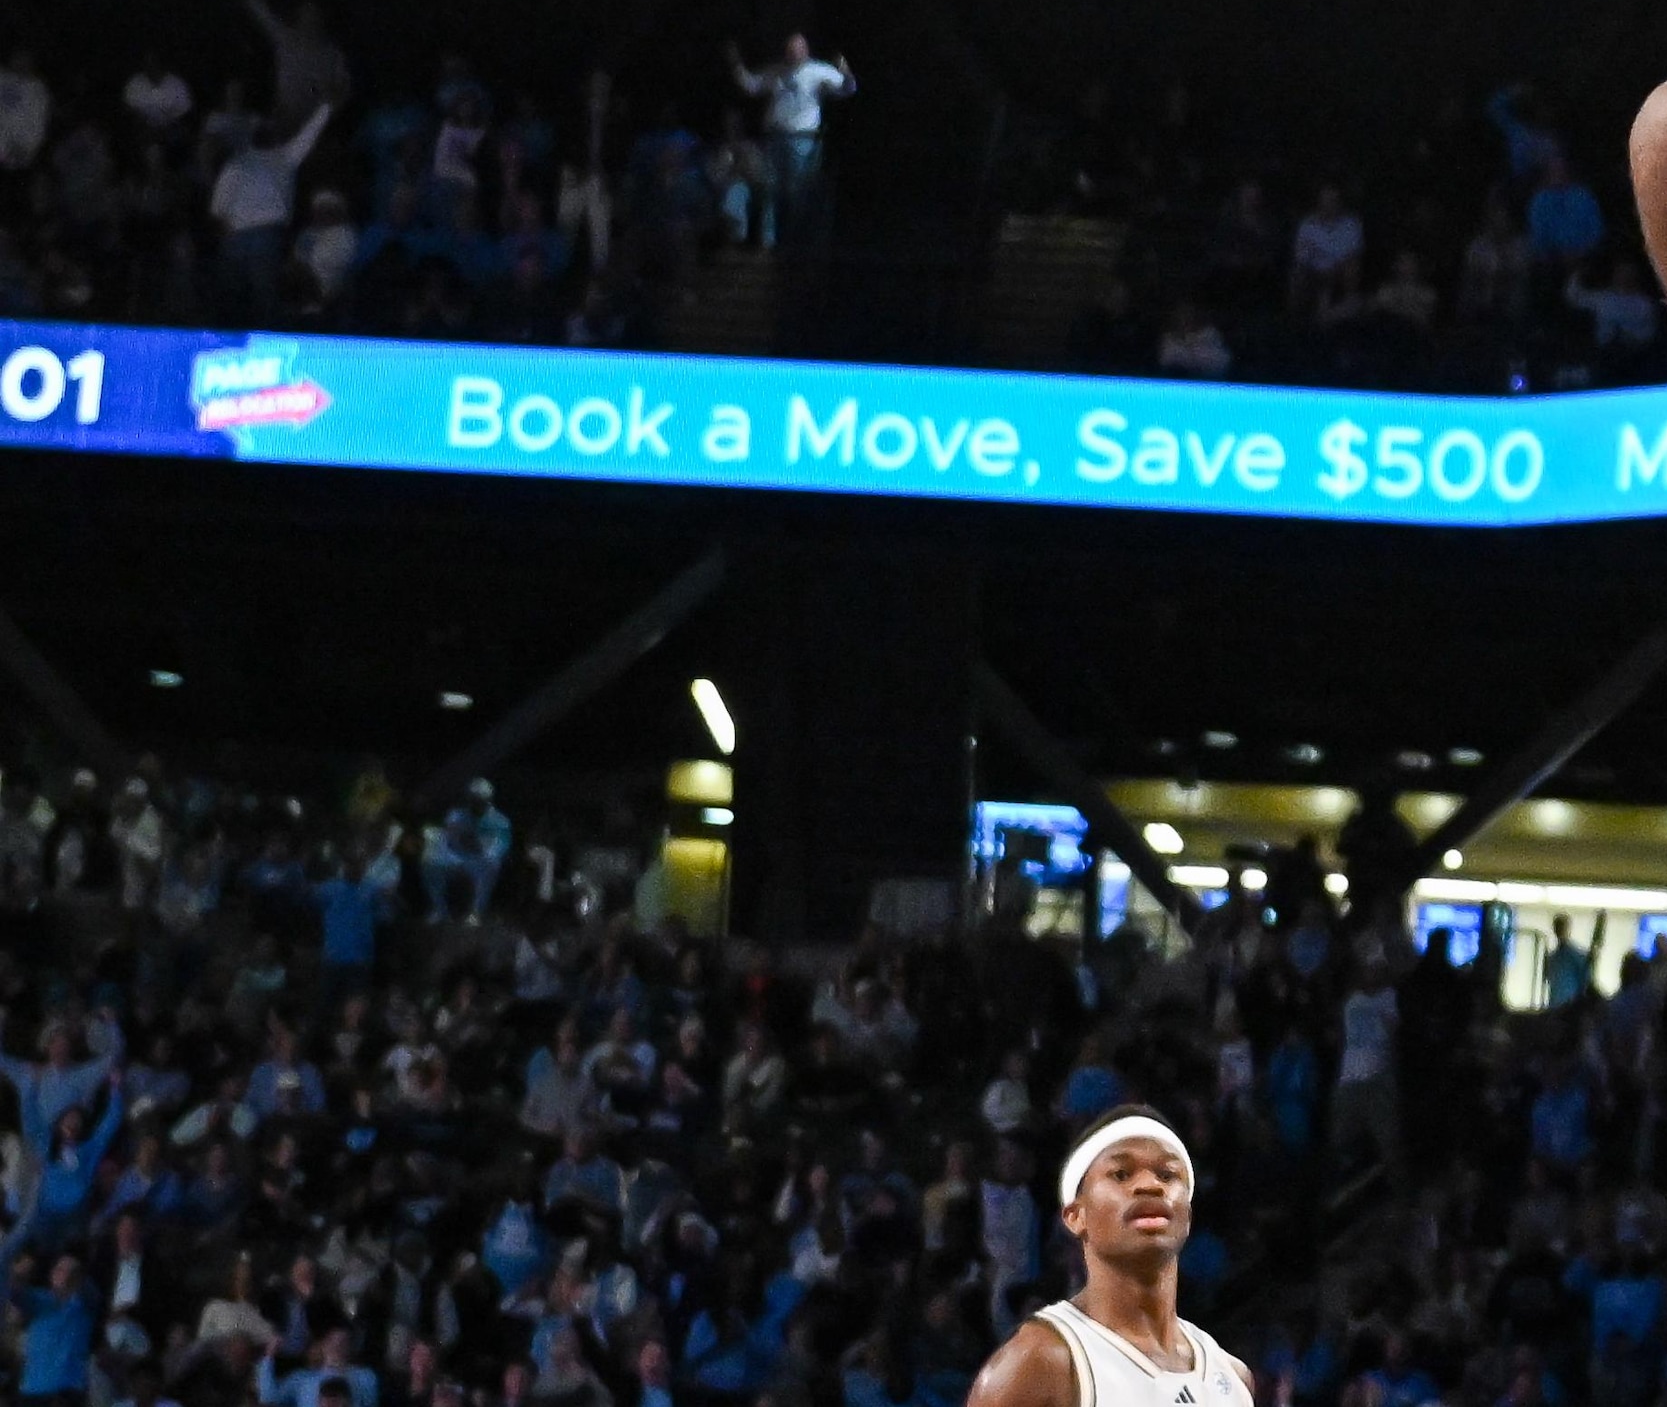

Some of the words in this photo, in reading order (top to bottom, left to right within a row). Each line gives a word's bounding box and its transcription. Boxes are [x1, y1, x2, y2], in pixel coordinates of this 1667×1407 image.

[0, 346, 106, 426] 01
[202, 357, 283, 394] PAGE
[448, 376, 673, 457] Book
[702, 405, 752, 462] a
[786, 396, 1041, 488] Move,
[1076, 407, 1287, 491] Save
[1317, 418, 1545, 502] $500
